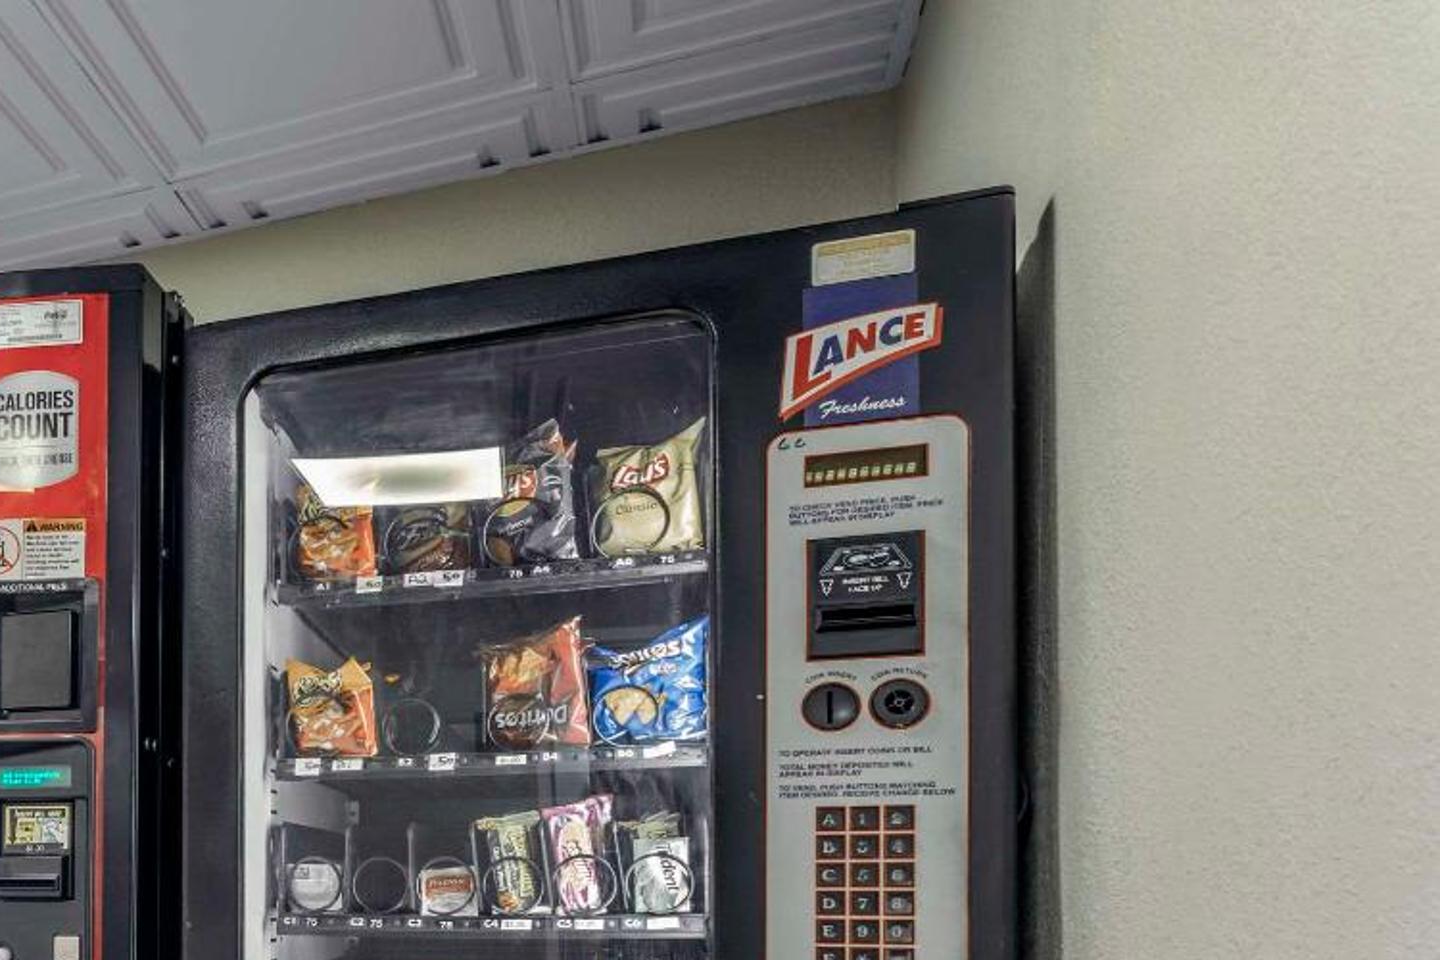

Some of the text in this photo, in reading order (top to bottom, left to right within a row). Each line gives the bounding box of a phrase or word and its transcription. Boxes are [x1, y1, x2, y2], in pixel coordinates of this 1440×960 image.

[792, 312, 926, 401] LANCE
[819, 395, 907, 418] Freshness
[495, 704, 568, 728] Doritos
[822, 814, 835, 825] A
[822, 869, 836, 881] C
[822, 898, 836, 909] D
[857, 898, 868, 909] 7
[822, 925, 836, 938] E
[857, 925, 868, 938] 9
